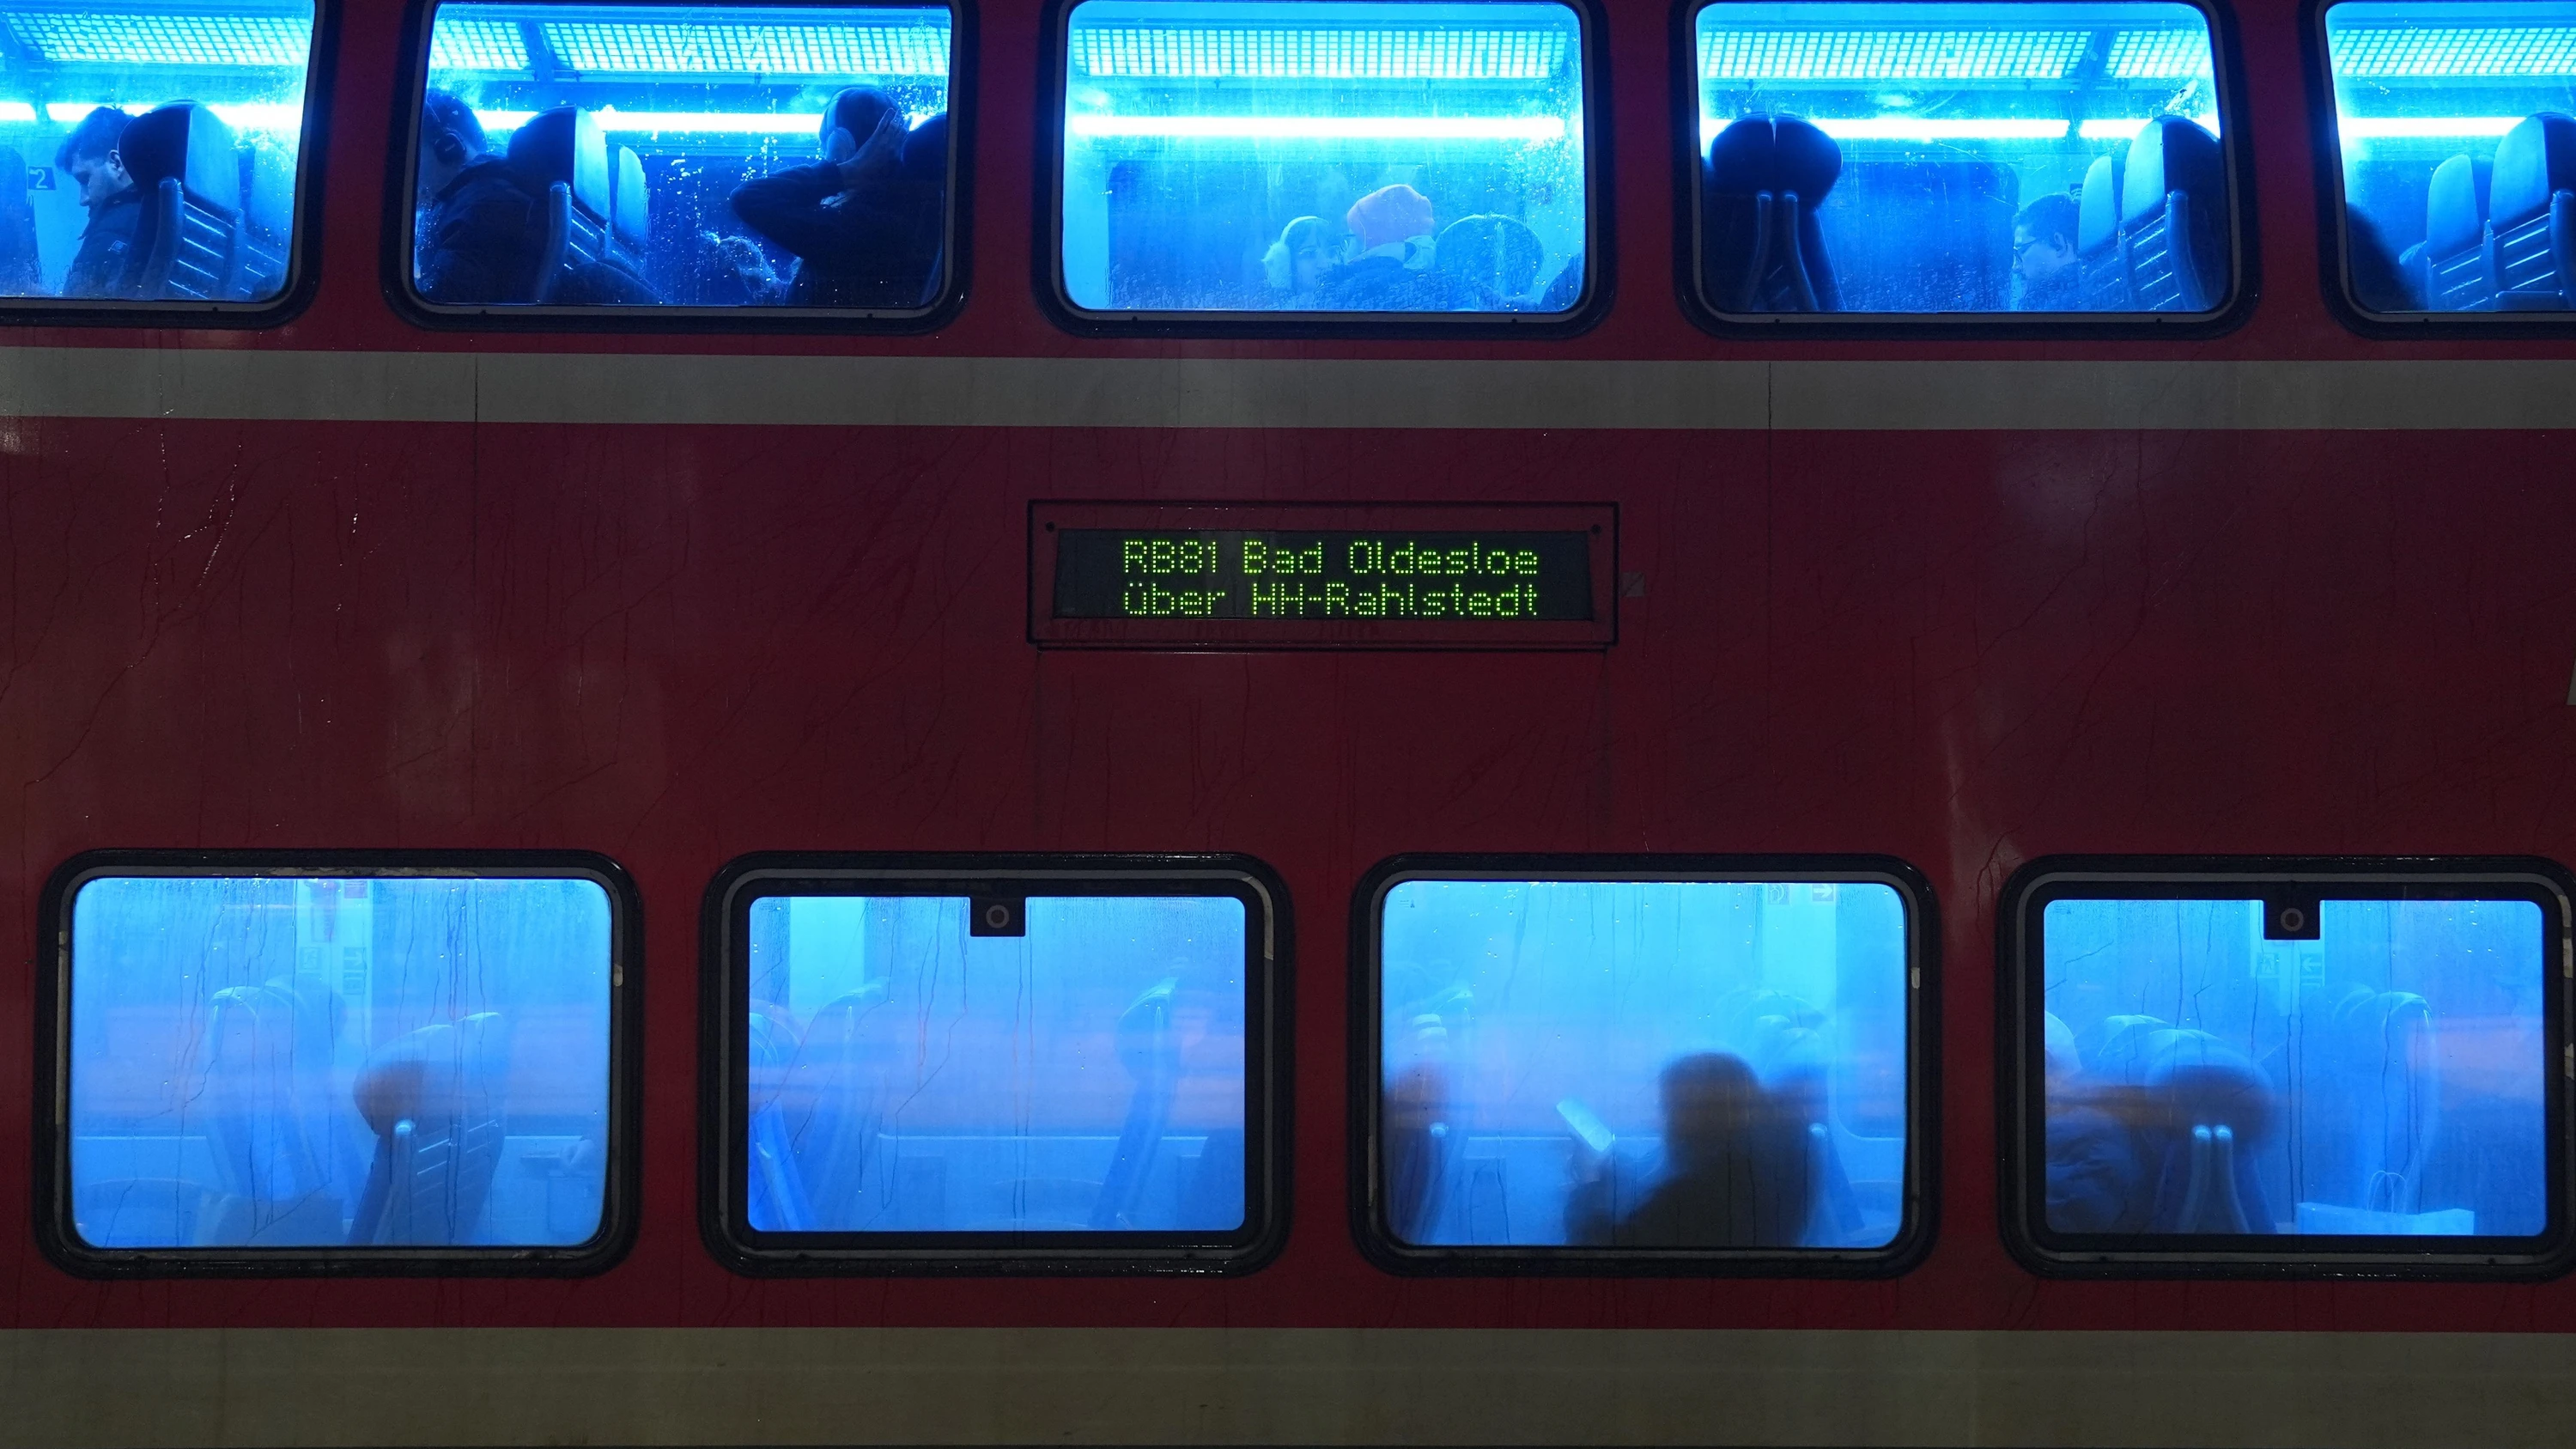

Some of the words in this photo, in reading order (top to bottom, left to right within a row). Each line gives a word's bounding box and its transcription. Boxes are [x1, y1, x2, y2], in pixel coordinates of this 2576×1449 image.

[29, 168, 48, 189] 2
[1125, 540, 1218, 574] RB81
[1243, 540, 1322, 574] Bad
[1349, 540, 1538, 575] Oldesloe
[1124, 582, 1225, 615] über
[1253, 582, 1538, 616] HH-Rahlstedt
